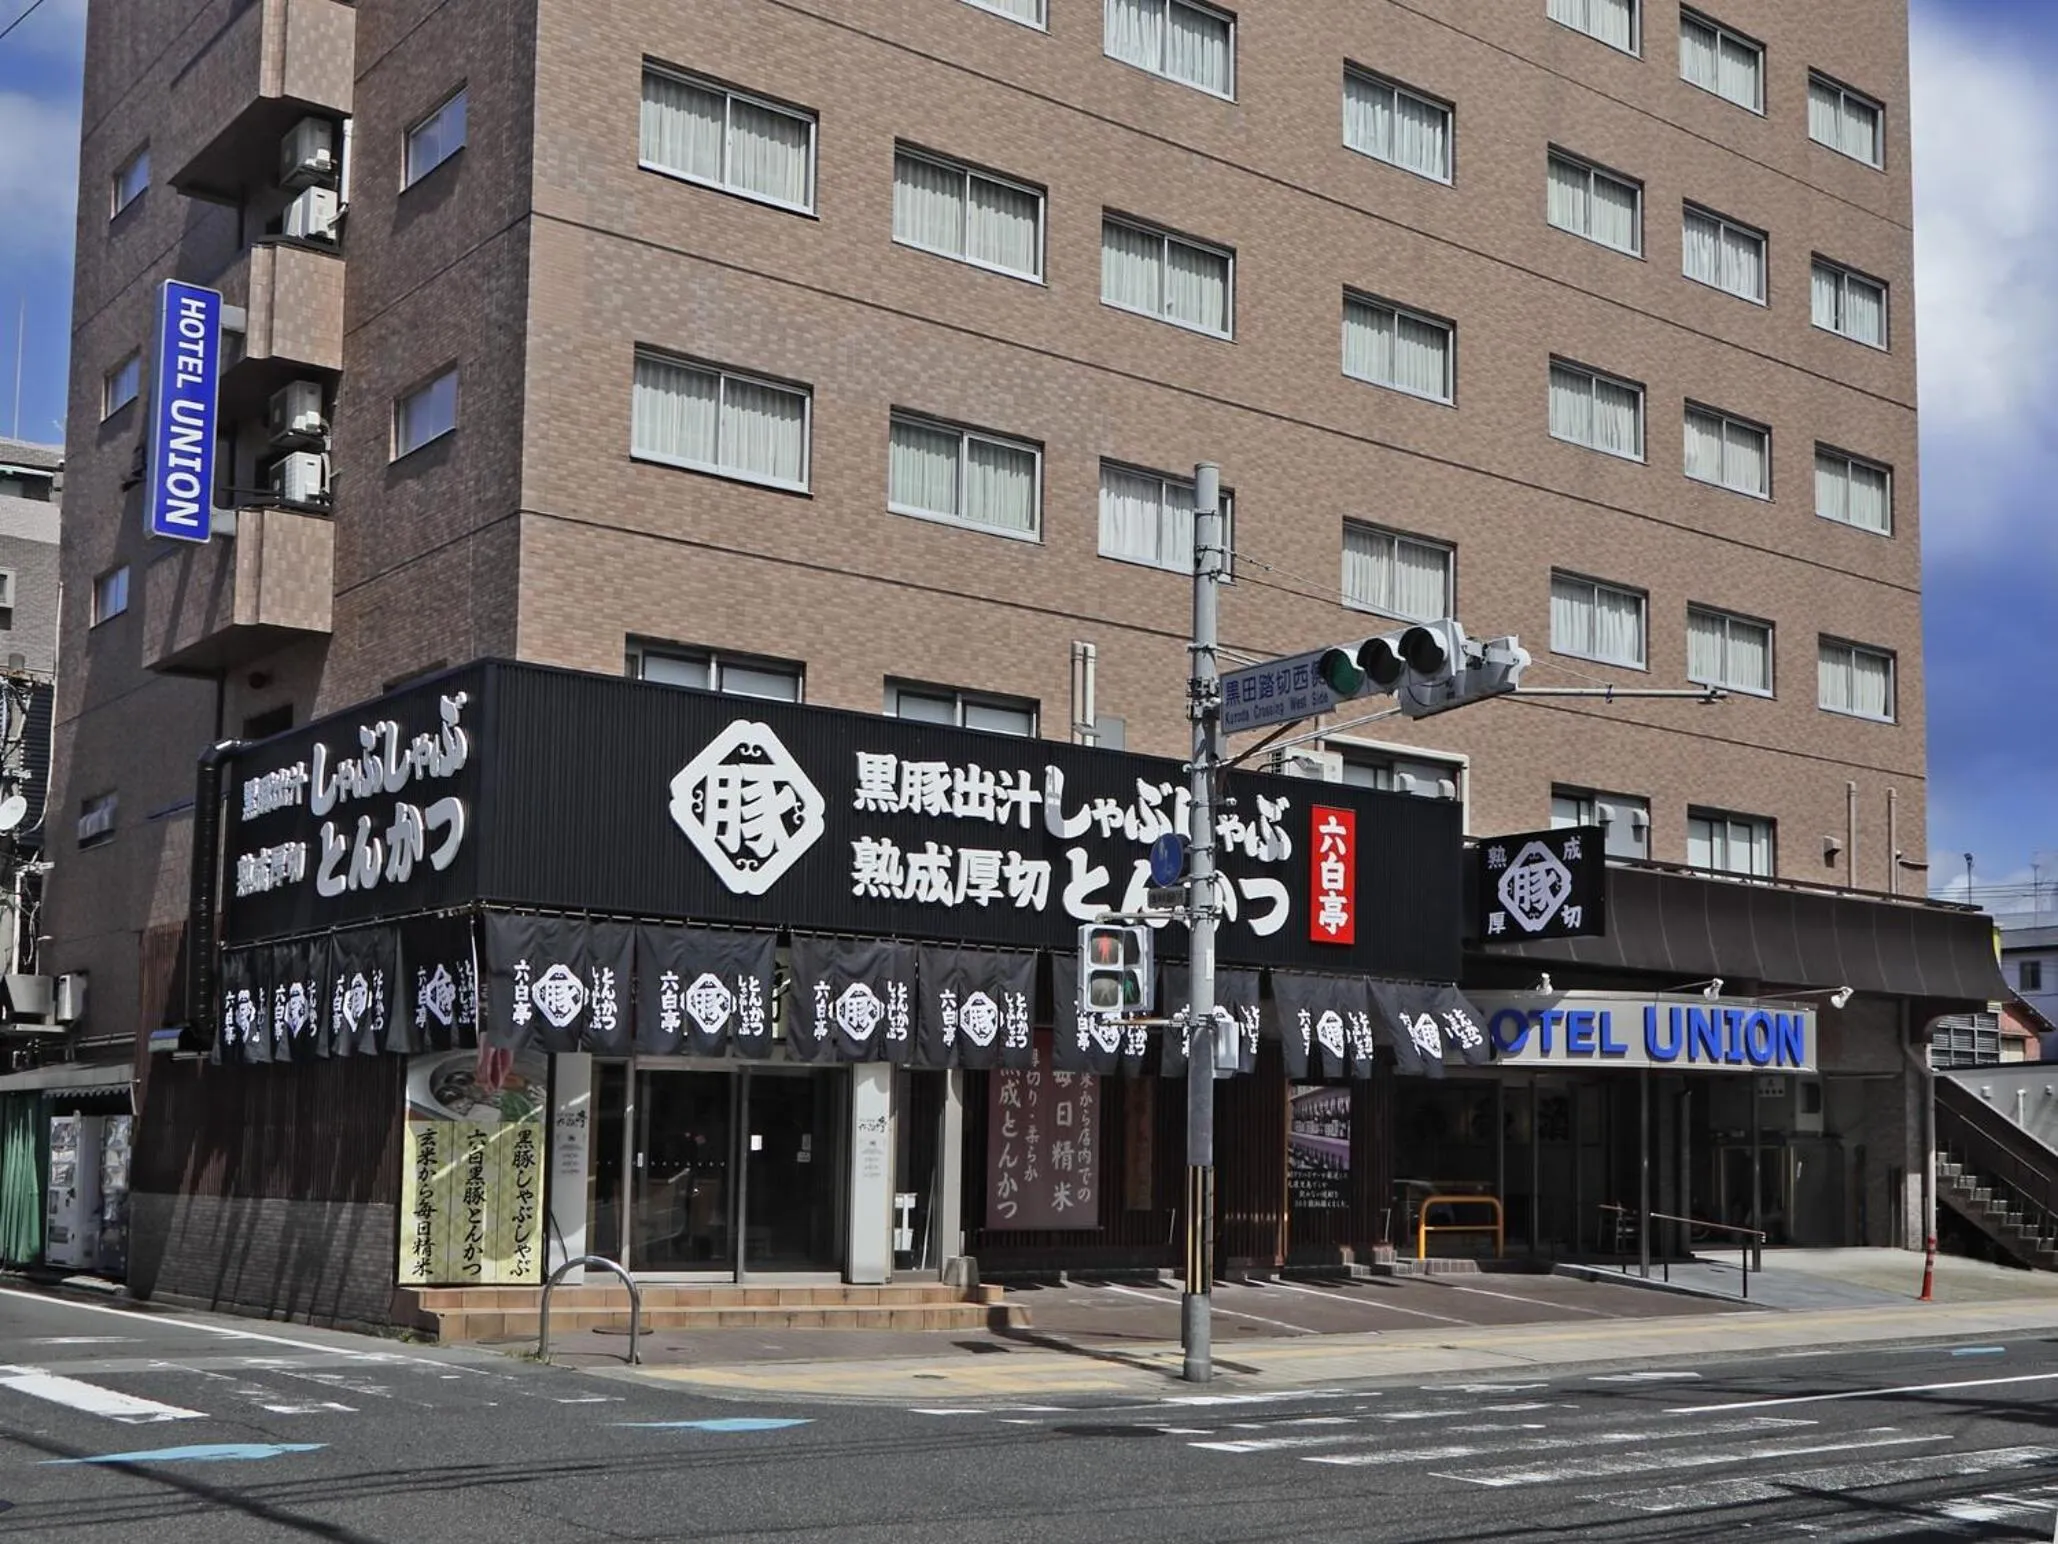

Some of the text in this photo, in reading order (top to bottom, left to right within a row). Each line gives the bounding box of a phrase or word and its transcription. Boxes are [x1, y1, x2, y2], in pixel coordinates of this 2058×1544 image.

[165, 297, 206, 527] HOTEL UNION
[1318, 815, 1348, 935] 六白亭
[1562, 835, 1582, 860] 成
[1487, 904, 1583, 935] 厚 切
[512, 959, 532, 1026] 六白亭
[601, 967, 618, 1030] とんかつ
[660, 970, 681, 1034] 六白亭
[749, 975, 764, 1036] とんかつ
[813, 980, 830, 1042] 六白亭
[896, 982, 909, 1041] とんかつ
[939, 988, 957, 1048] 六白亭
[1016, 992, 1029, 1049] とんかつ
[1489, 1005, 1806, 1068] OTEL UNION
[997, 1069, 1021, 1219] 成とんかつ
[412, 1128, 438, 1277] 玄米から毎日精米
[462, 1129, 488, 1277] 六白黒豚とんかつ
[510, 1129, 536, 1277] 黒豚しゃぶしゃぶ
